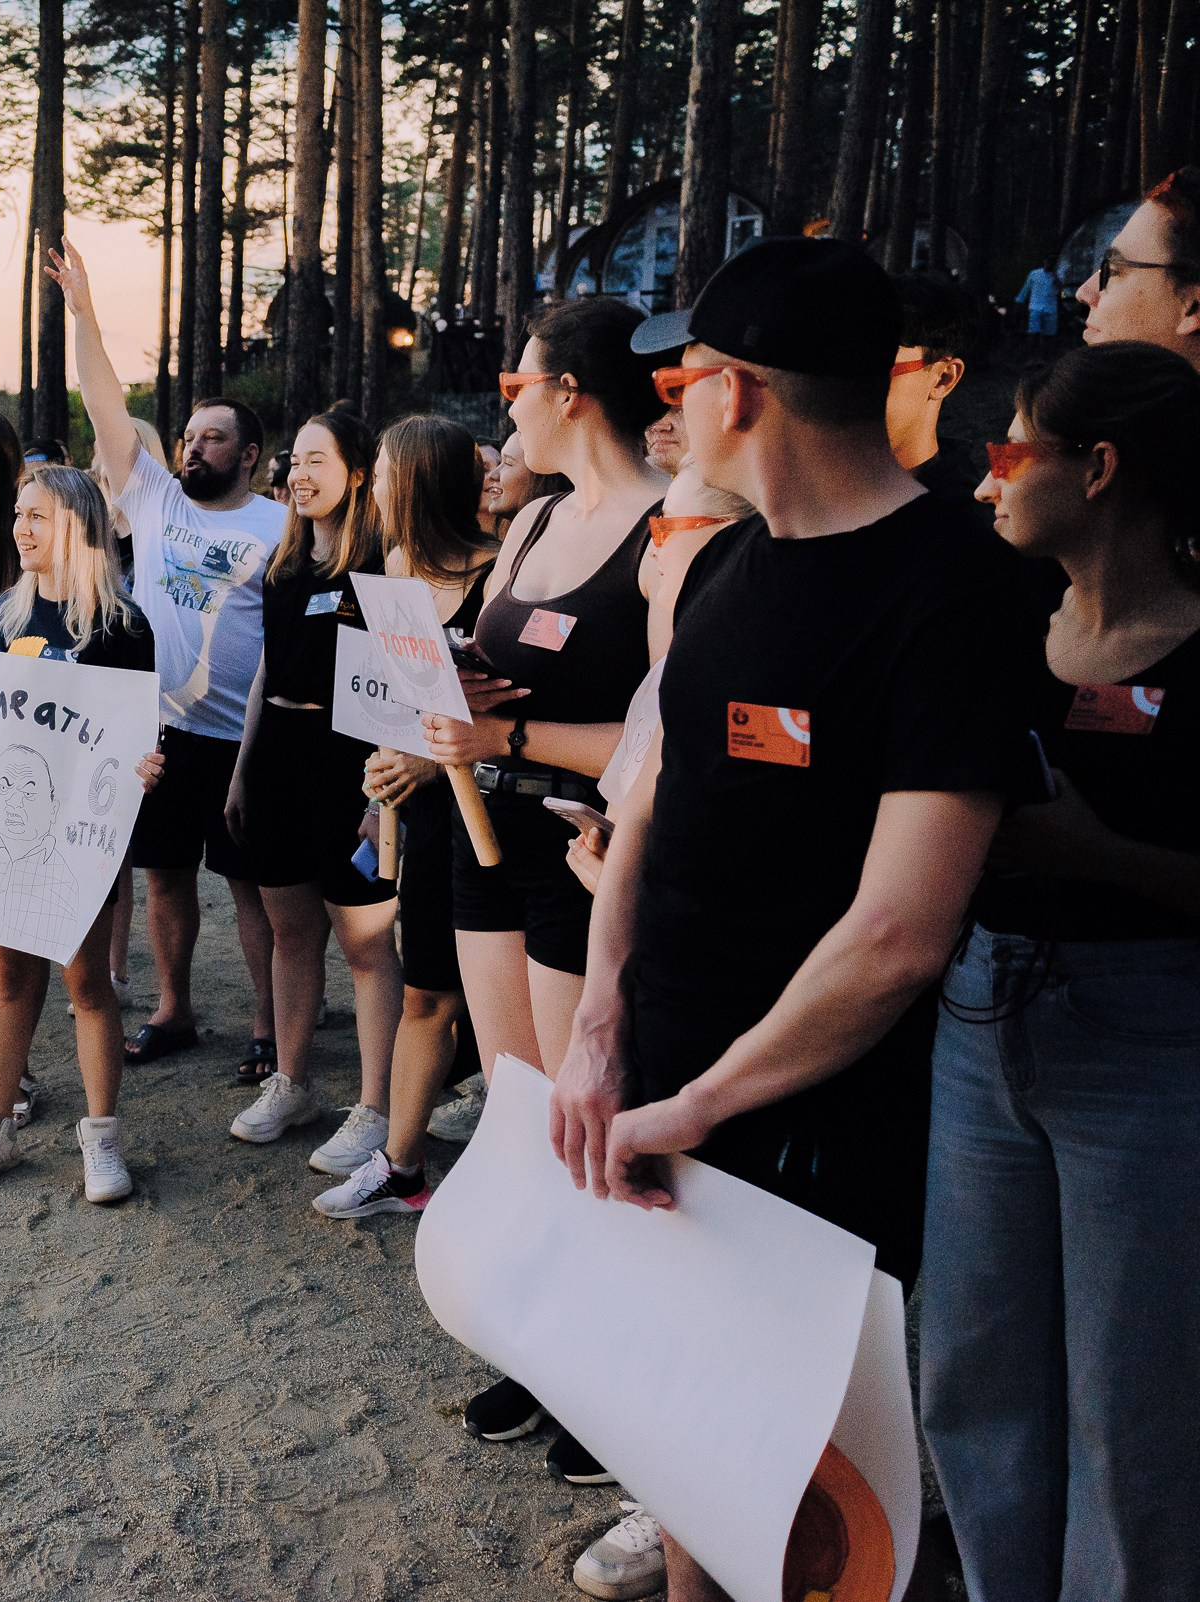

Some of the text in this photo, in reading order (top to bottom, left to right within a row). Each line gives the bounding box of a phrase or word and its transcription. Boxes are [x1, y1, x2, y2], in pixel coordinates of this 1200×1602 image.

[378, 631, 446, 670] 7 ОТРЯД
[351, 675, 361, 693] 6
[88, 757, 120, 817] 6
